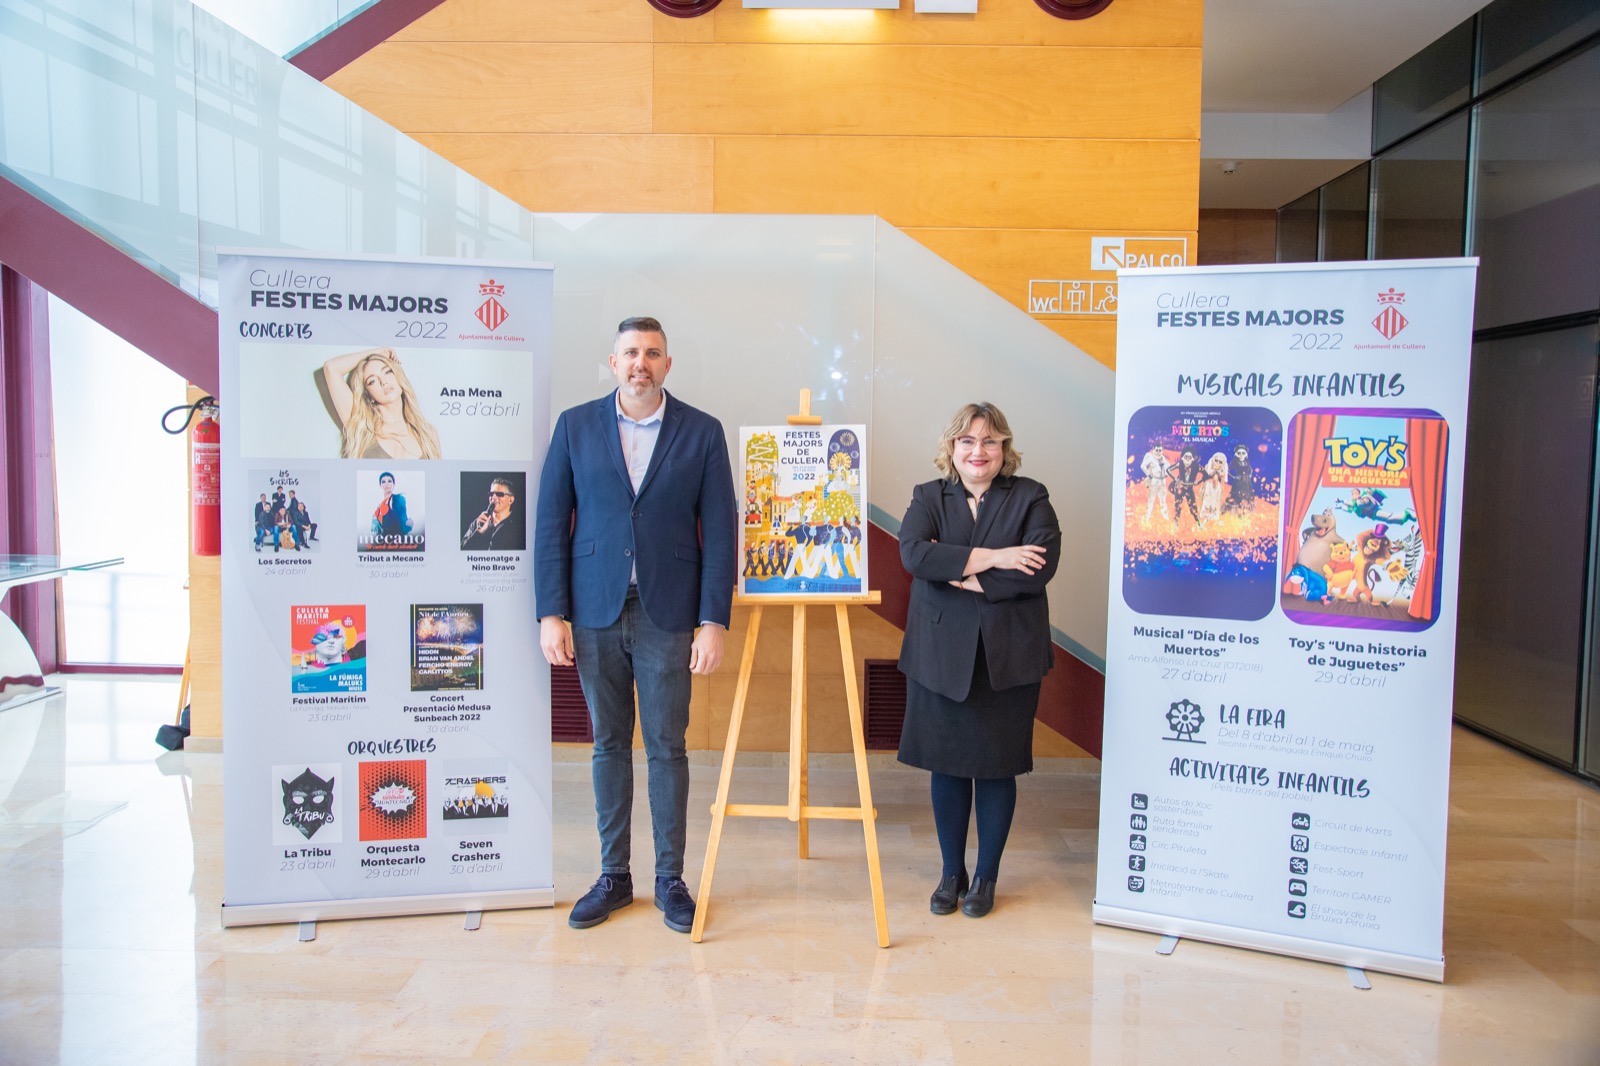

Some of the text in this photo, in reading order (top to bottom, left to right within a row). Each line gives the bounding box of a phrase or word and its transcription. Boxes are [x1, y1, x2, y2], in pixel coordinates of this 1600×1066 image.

[1126, 254, 1182, 268] PALCO
[250, 269, 331, 290] Cullera
[251, 290, 448, 314] FESTES MAJORS
[1032, 298, 1058, 312] WC
[1157, 291, 1230, 309] Cullera
[1158, 310, 1344, 327] FESTES MAJORS
[240, 321, 313, 340] CONCERTS
[395, 320, 448, 339] 2022
[1289, 333, 1343, 350] 2022
[1178, 372, 1405, 398] MUSICALS INFANTILS
[440, 388, 502, 398] Ana Mena
[440, 402, 520, 417] 28 d'abril
[1172, 426, 1230, 437] MUERTOS
[784, 440, 823, 448] MAJORS
[797, 448, 810, 456] DE
[781, 457, 825, 465] CULLERA
[793, 473, 815, 481] 2022
[1328, 467, 1408, 479] UNA HISTORIA
[1348, 476, 1401, 486] JUGUETES
[359, 534, 425, 544] mecano
[265, 568, 276, 576] 24
[369, 571, 380, 579] 30
[1134, 626, 1184, 639] Musical
[1219, 632, 1236, 643] de
[1240, 633, 1260, 645] los
[1289, 638, 1325, 652] Toy's
[1368, 643, 1427, 658] historia
[1128, 654, 1150, 664] Amb
[1151, 656, 1184, 666] Alfonso
[1201, 660, 1222, 669] Cruz
[1308, 655, 1326, 666] de
[1161, 668, 1179, 680] 27
[1314, 671, 1334, 683] 29
[331, 696, 366, 704] Marítim
[430, 695, 464, 703] Concert
[404, 704, 491, 713] Presentació Medusa
[308, 714, 320, 722] 23
[414, 713, 481, 722] Sunbeach 2022
[1220, 704, 1286, 729] LA FIRA
[426, 725, 438, 733] 30
[1218, 727, 1239, 738] Del
[1242, 730, 1250, 740] 8
[1295, 736, 1308, 746] al
[1318, 738, 1336, 748] de
[1311, 749, 1343, 760] Enrique
[1170, 757, 1370, 798] ACTIVITATS INFANTILS
[1235, 786, 1262, 796] barris
[1265, 788, 1280, 798] del
[1154, 796, 1213, 810] Autos de Xoc
[1153, 804, 1204, 817] sostenibles
[1153, 816, 1213, 831] Ruta familiar
[1314, 819, 1393, 837] Circuit de Karts
[1152, 825, 1200, 837] senderista
[367, 844, 420, 856] Orquesta
[460, 840, 493, 850] Seven
[1152, 840, 1207, 855] Circ Piruleta
[284, 849, 331, 859] La Tribu
[452, 851, 501, 862] Crashers
[1314, 841, 1408, 862] Espectacle Infantil
[280, 861, 296, 871] 23
[361, 855, 426, 868] Montecarlo
[1150, 861, 1188, 874] Iniciació
[366, 869, 381, 879] 29
[450, 865, 464, 875] 30
[1313, 864, 1364, 879] Fest-Sport
[1150, 878, 1254, 902] Metroteatre de Cullera
[1150, 887, 1182, 898] Infantil
[1312, 886, 1392, 905] Territori GAMER
[1311, 903, 1376, 922] El show de la
[1310, 912, 1380, 930] Bruixa Piruixa
